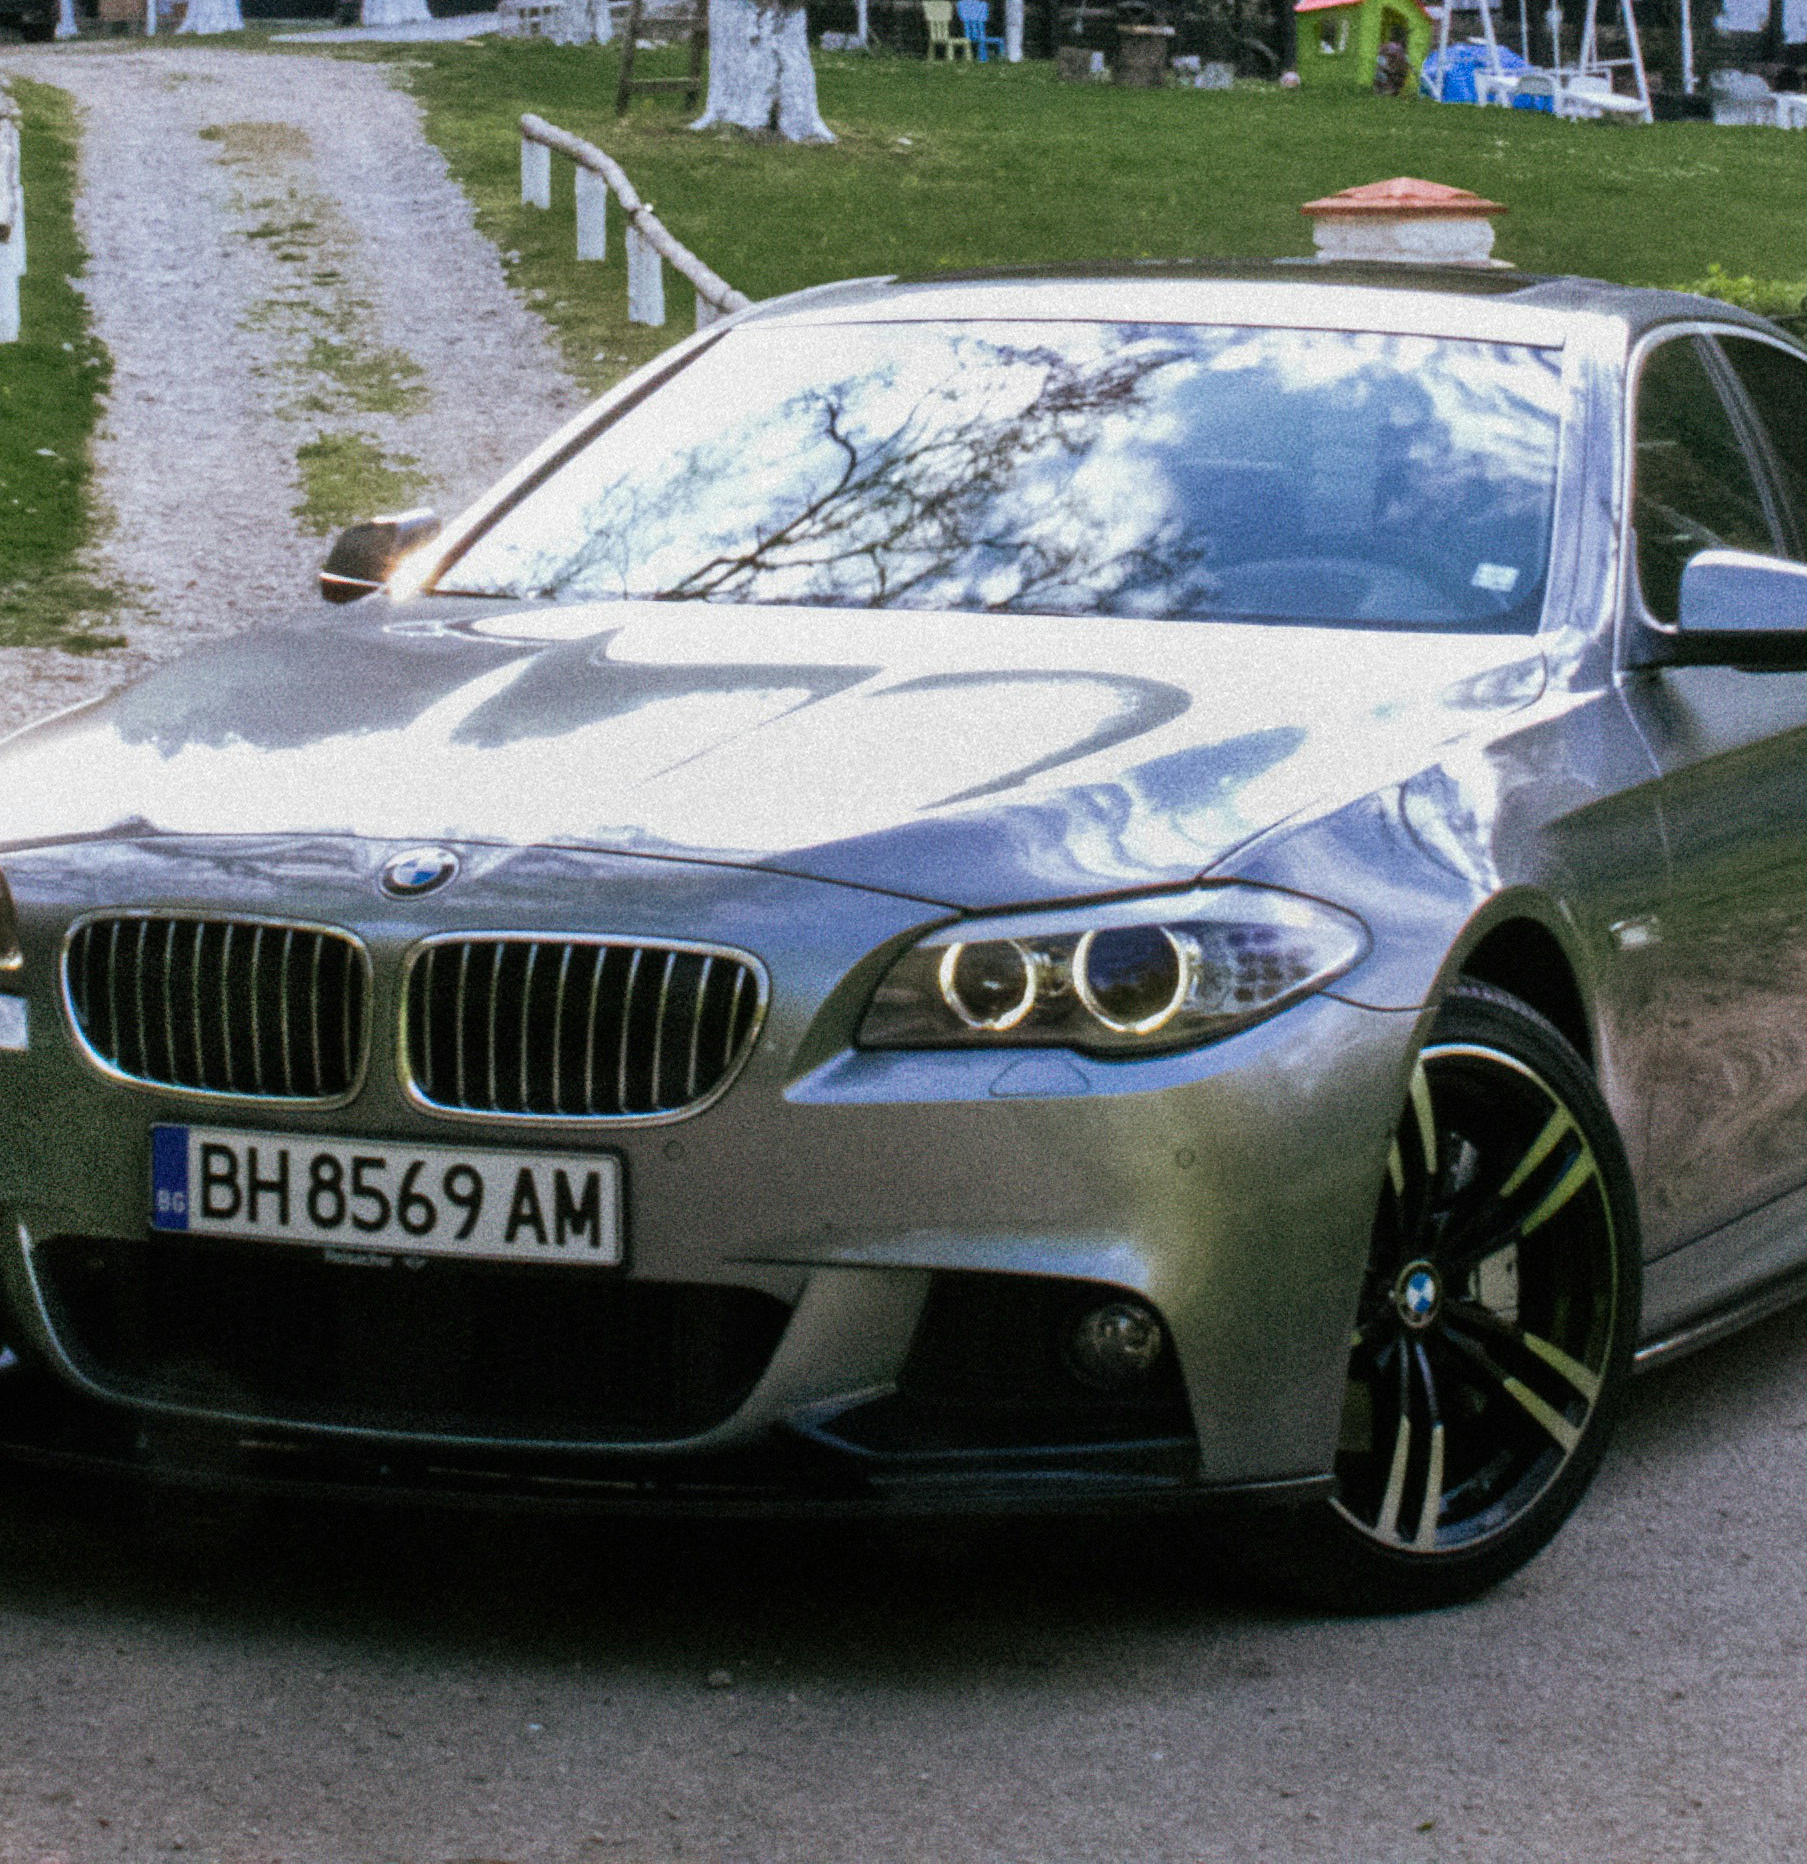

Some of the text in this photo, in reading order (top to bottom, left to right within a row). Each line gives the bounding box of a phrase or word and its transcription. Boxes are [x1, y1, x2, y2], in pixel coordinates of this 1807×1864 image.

[157, 1188, 186, 1214] BG
[200, 1142, 602, 1249] BH 8569 AM
